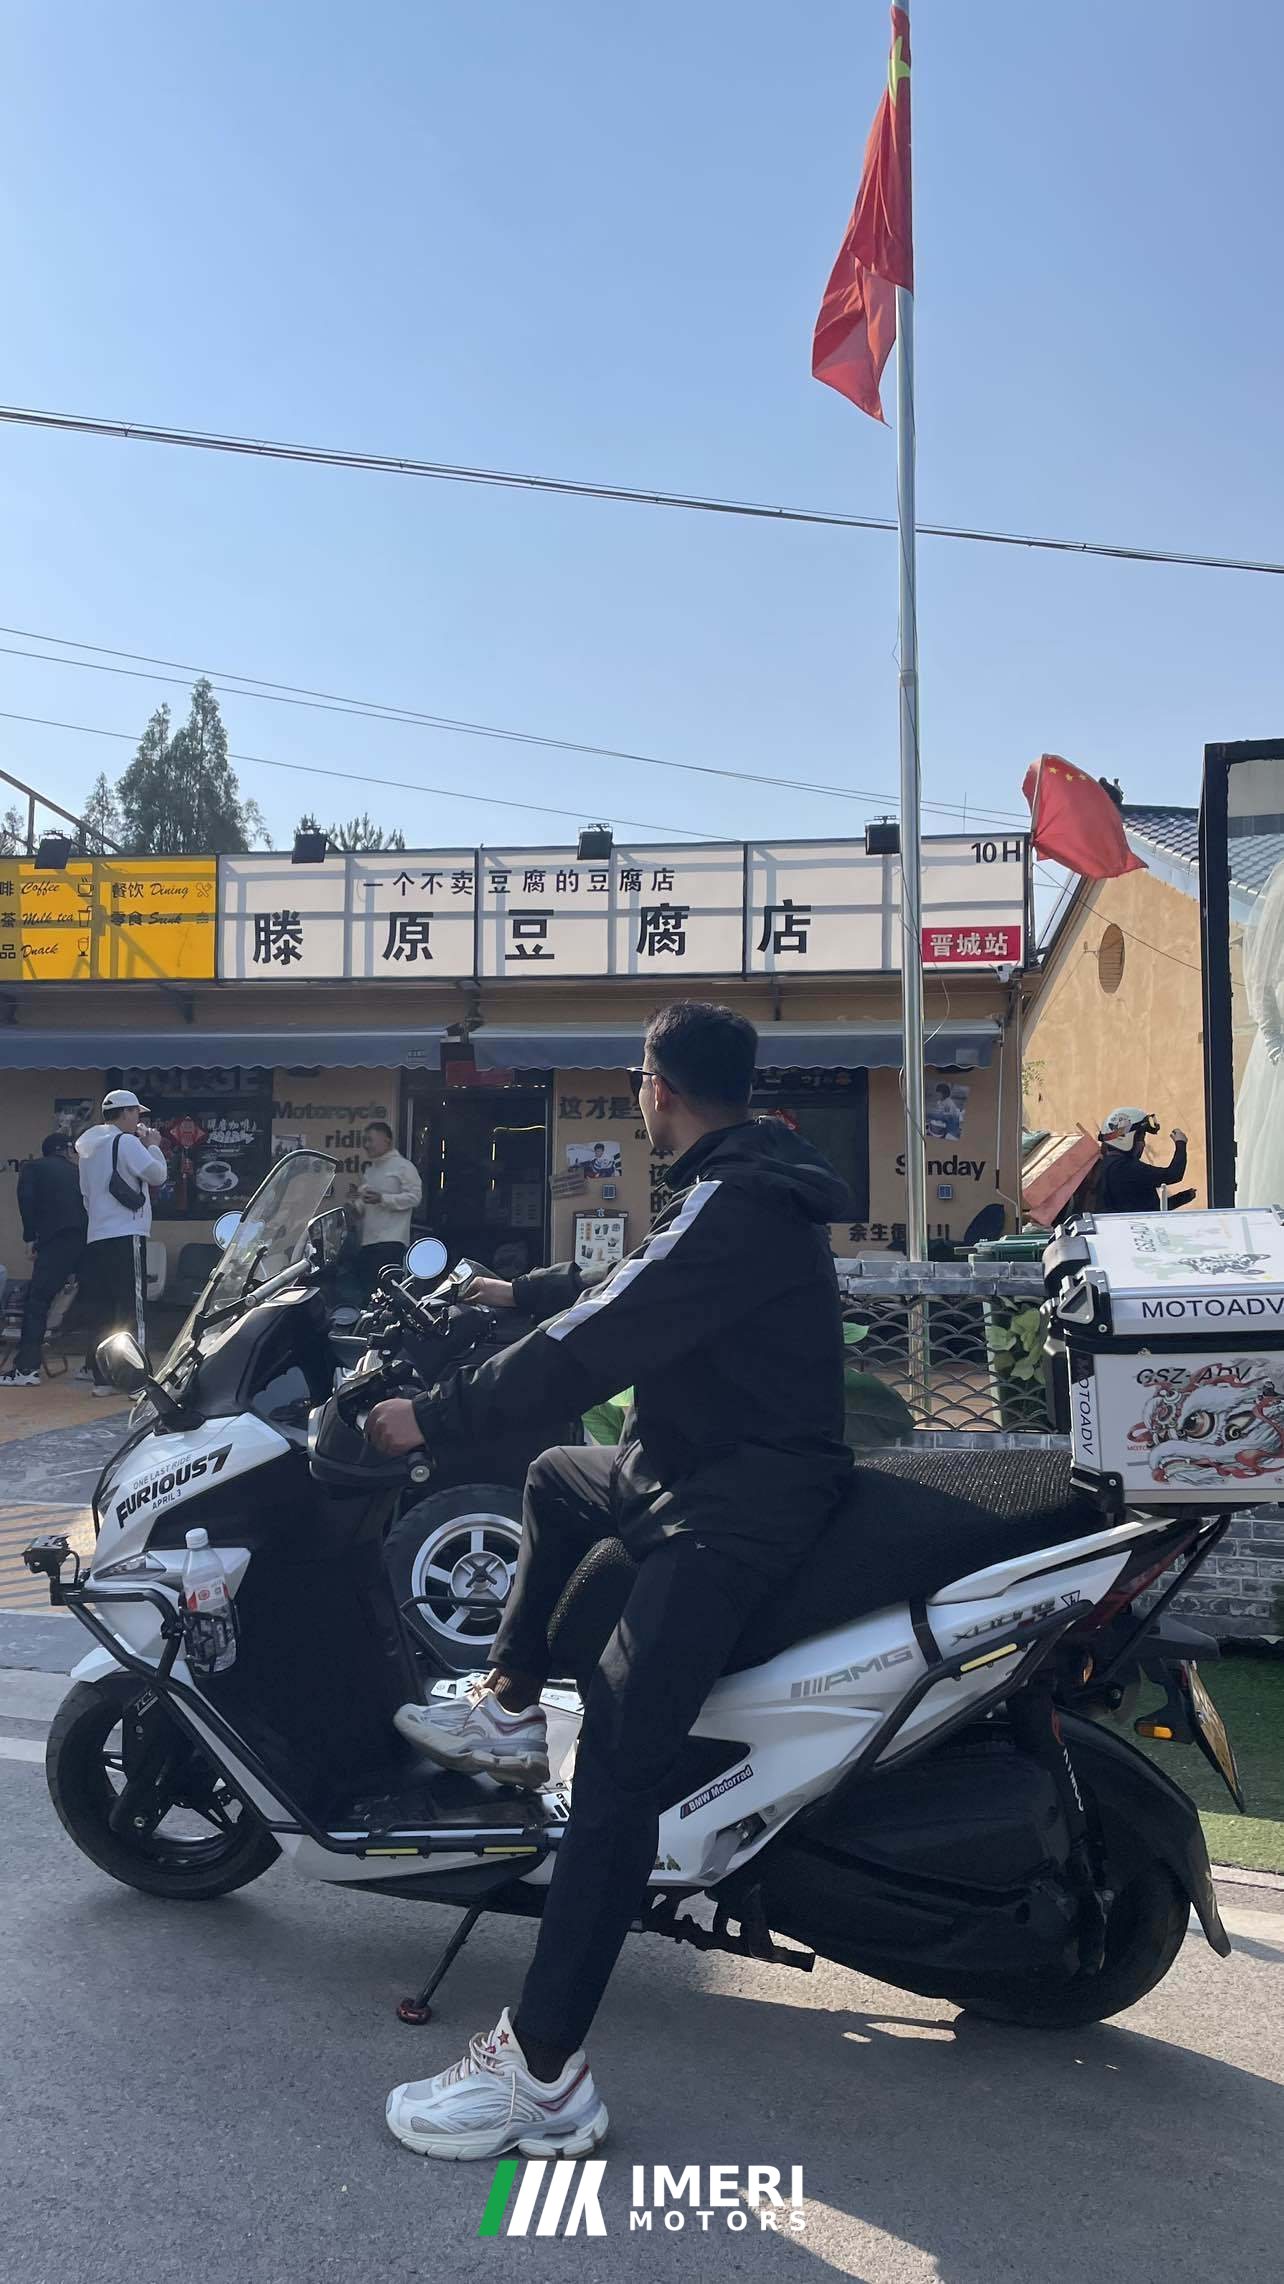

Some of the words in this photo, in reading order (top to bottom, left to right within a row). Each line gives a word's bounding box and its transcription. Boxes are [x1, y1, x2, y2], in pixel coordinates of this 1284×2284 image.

[21, 880, 61, 896] Coffee
[112, 882, 144, 898] 餐饮
[150, 882, 189, 898] Dining
[363, 867, 676, 896] 一个不卖豆腐的豆腐店
[1, 911, 16, 928] 茶
[22, 911, 53, 926] Milk
[57, 912, 74, 923] tea
[930, 933, 1010, 958] 晋城站
[272, 1101, 387, 1124] Motorcycle
[896, 1153, 986, 1181] Snday
[1142, 1298, 1284, 1319] MOTOADV
[133, 1475, 149, 1490] ONE
[150, 1463, 172, 1481] LAST
[171, 1455, 192, 1471] RIDE
[152, 1494, 176, 1510] APRIL
[177, 1488, 182, 1498] 3
[824, 1645, 913, 1692] AMG
[687, 1791, 711, 1812] BMW
[710, 1765, 753, 1799] Motorrad
